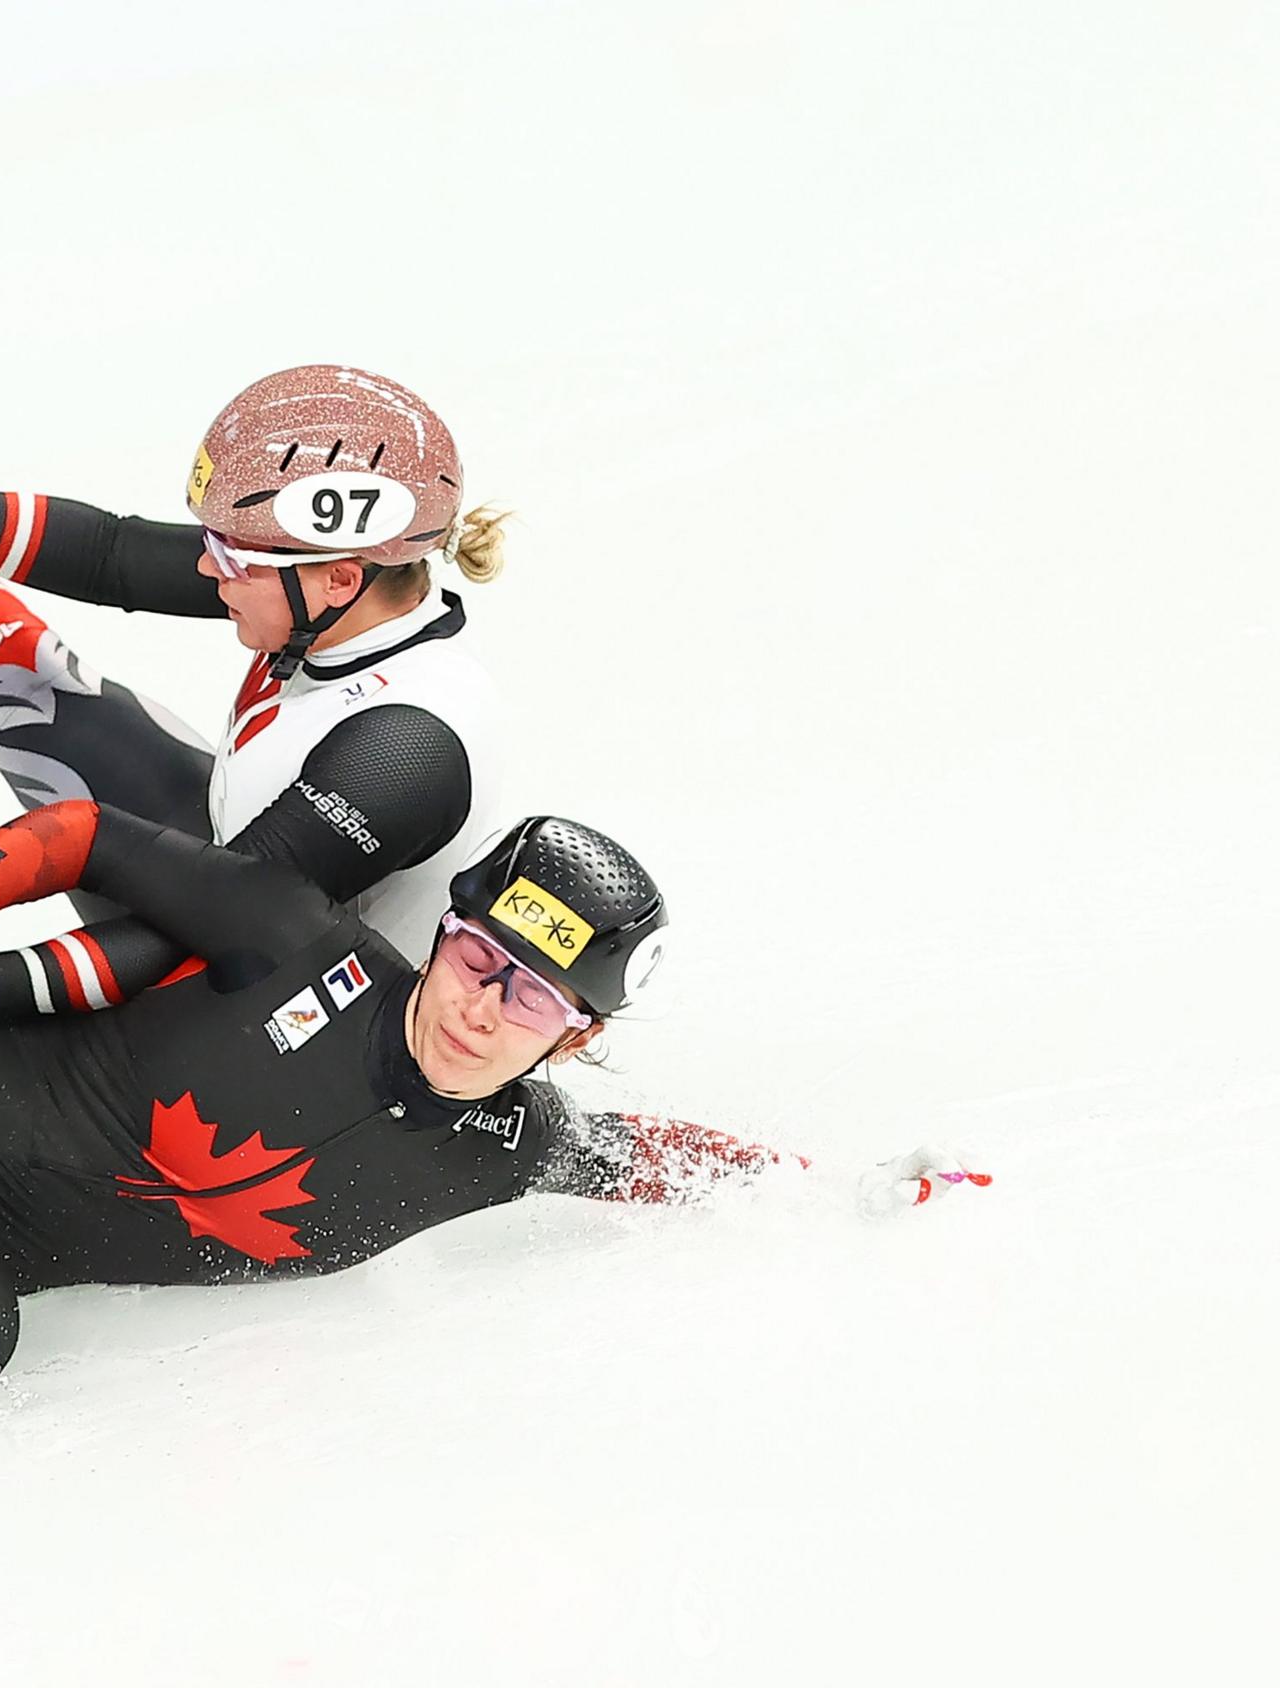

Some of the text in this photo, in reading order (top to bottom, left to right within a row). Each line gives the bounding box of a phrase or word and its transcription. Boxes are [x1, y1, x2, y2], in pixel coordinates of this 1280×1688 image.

[312, 488, 380, 534] 97
[295, 780, 380, 854] HUSSARS
[327, 791, 369, 825] POLISH
